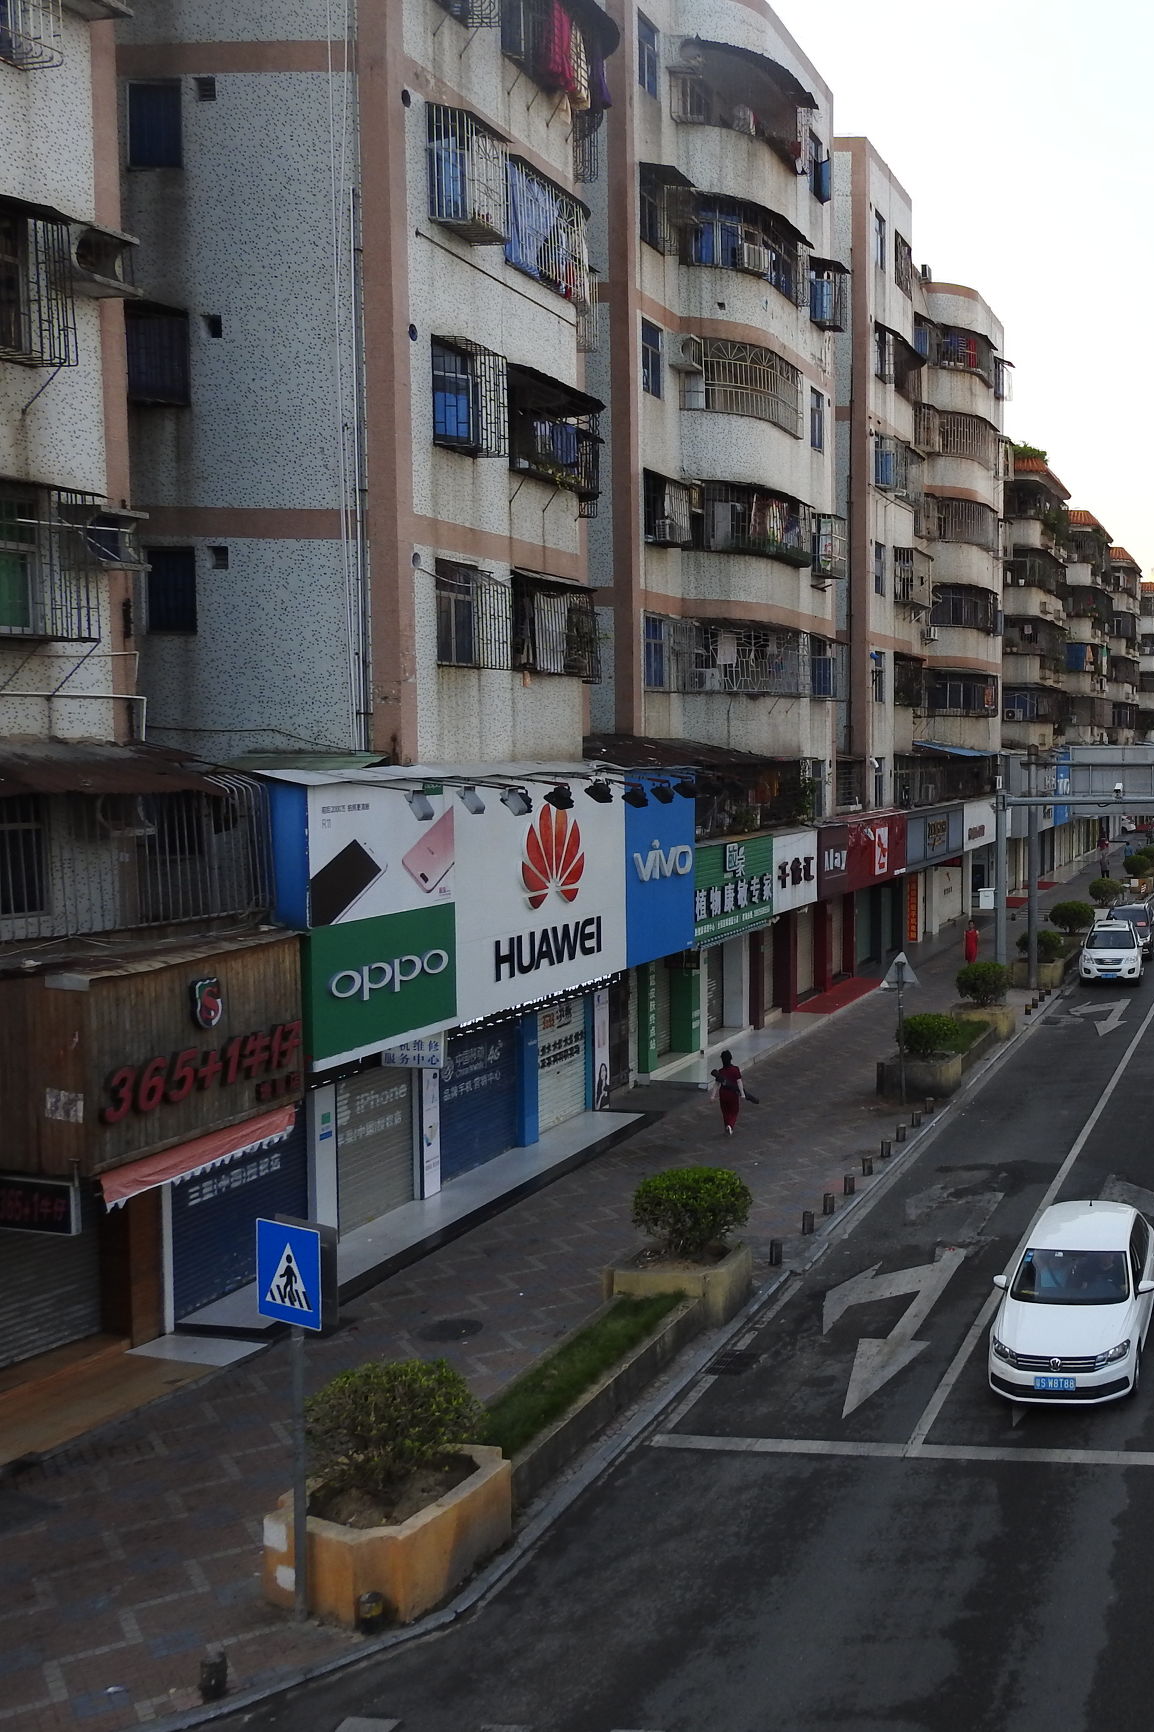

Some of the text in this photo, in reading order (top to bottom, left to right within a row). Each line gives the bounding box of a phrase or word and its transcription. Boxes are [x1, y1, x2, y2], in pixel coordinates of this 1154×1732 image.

[633, 840, 693, 882] vivo
[495, 916, 602, 983] HUAWEI
[384, 1053, 440, 1065] 服务中心
[387, 1039, 440, 1052] 机维修
